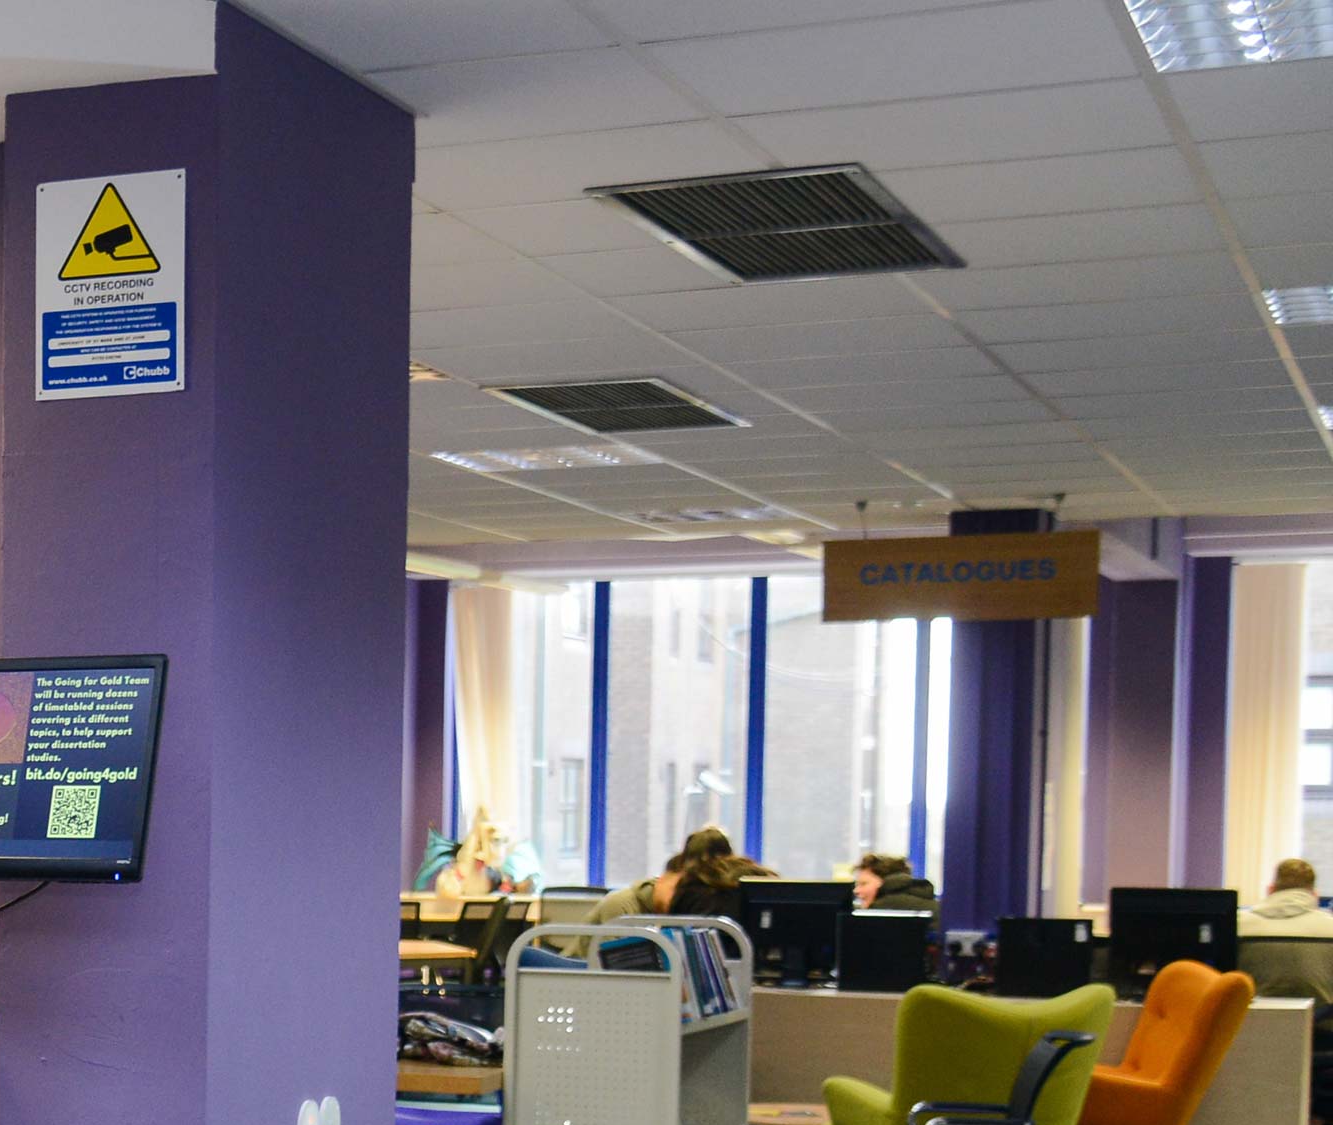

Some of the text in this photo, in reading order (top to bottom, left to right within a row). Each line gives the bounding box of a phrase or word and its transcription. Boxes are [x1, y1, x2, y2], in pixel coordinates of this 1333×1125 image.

[64, 278, 154, 294] CCTV RECORDING
[74, 292, 144, 306] IN OPERATION
[136, 366, 170, 377] Chubb
[48, 375, 108, 385] www.chubb.co.uk
[859, 558, 1058, 587] CATALOGUES
[37, 676, 149, 688] The Going for Gold Team
[35, 689, 138, 700] will be running dozens
[32, 701, 134, 712] of timetabled sessions
[31, 714, 129, 726] covering six different
[30, 727, 133, 738] topics, to help support
[28, 740, 107, 751] your dissertation
[26, 753, 62, 762] studies.
[25, 767, 138, 783] bit.do/going4gold
